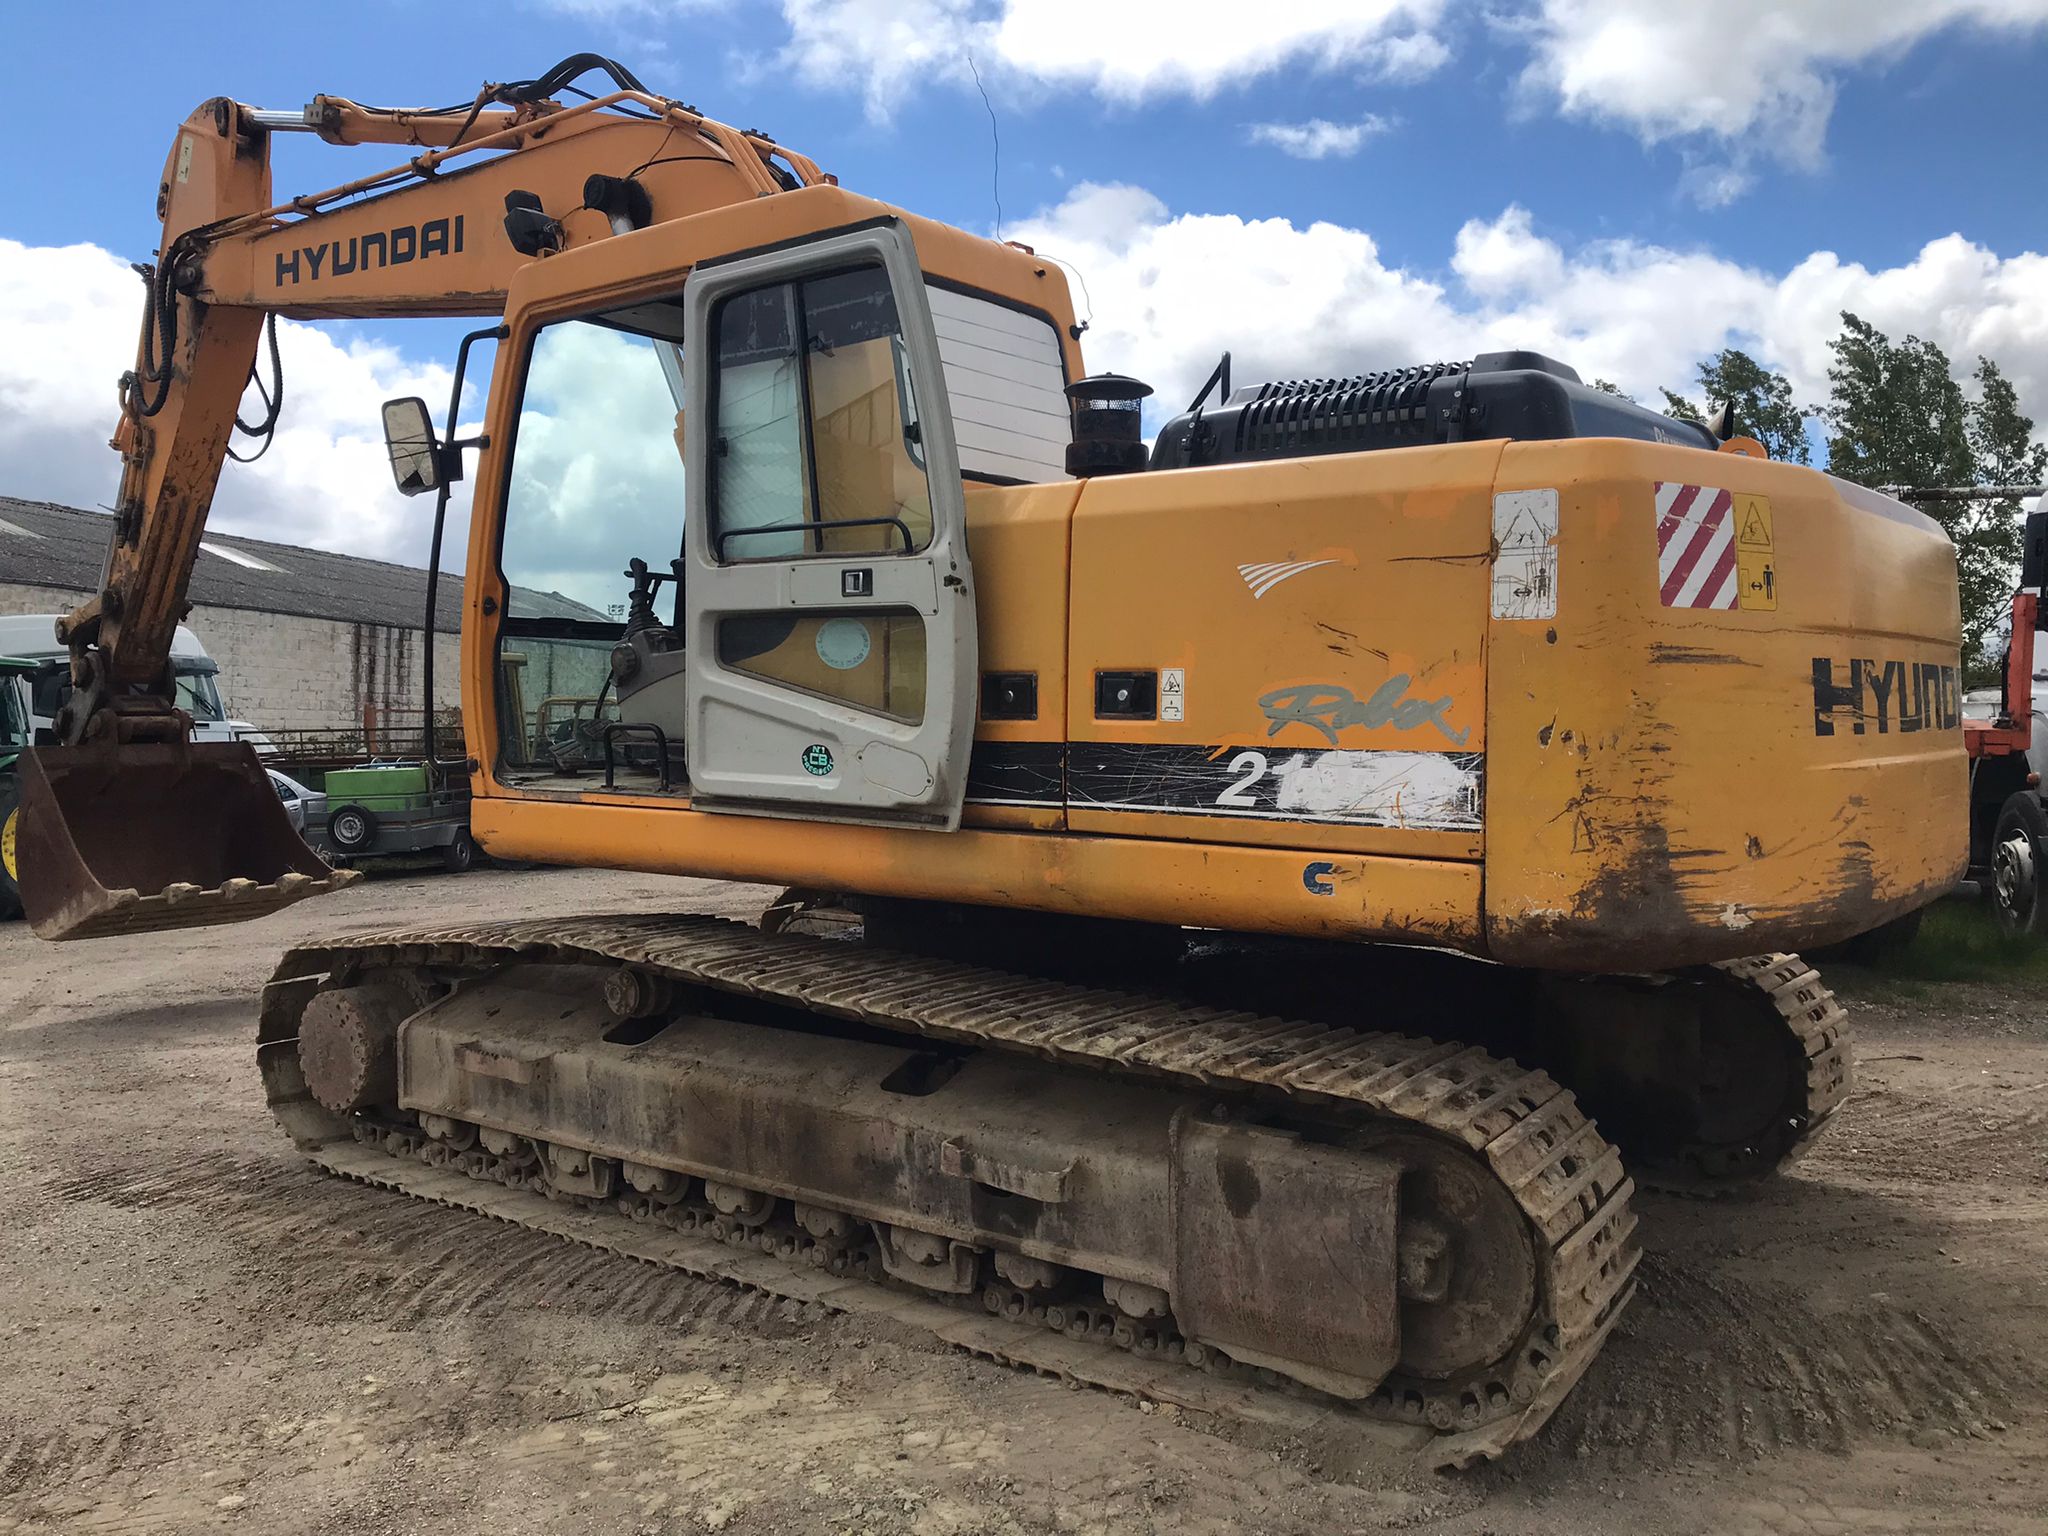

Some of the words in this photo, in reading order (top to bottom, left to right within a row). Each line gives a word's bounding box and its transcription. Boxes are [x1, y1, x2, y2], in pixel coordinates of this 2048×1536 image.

[276, 215, 464, 287] HYUNDAI
[1258, 673, 1471, 746] Robex
[1812, 657, 1962, 736] HYUND
